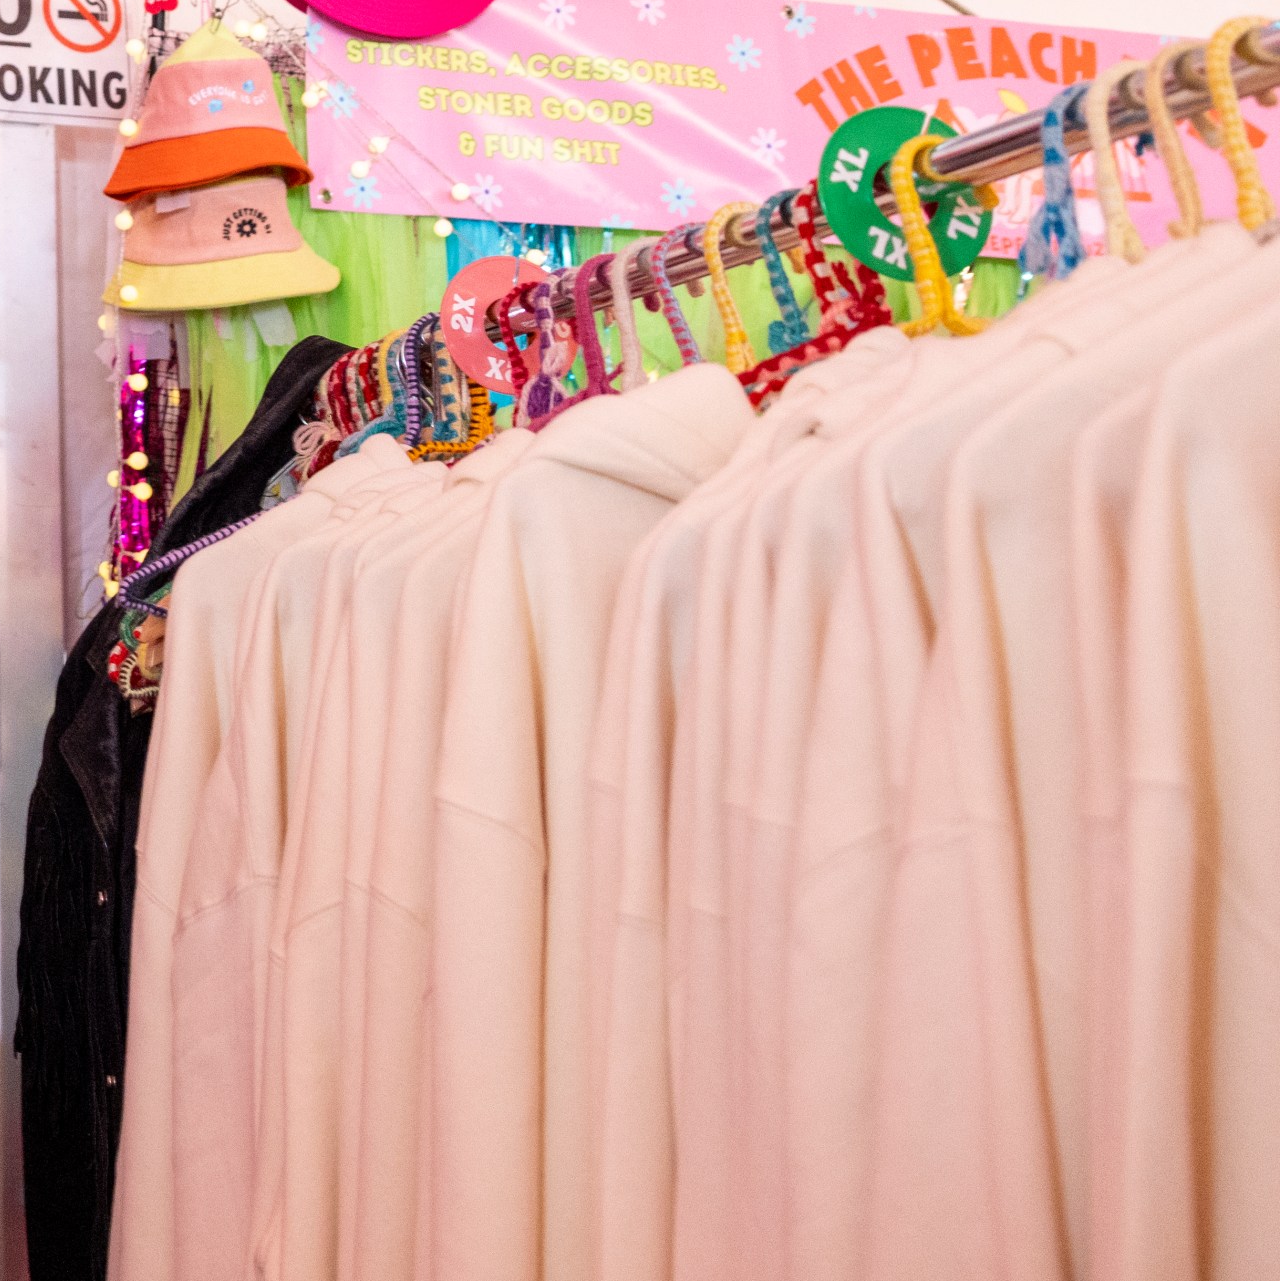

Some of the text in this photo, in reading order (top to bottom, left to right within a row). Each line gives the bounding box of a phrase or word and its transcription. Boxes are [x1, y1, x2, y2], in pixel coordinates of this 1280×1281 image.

[345, 38, 728, 94] STICKERS, ACCESSORIES,
[794, 26, 1098, 135] THE PEACH
[416, 85, 655, 128] STONER GOODS
[457, 130, 621, 166] & FUN SHIT
[829, 147, 870, 193] XL
[222, 217, 234, 241] JUST
[232, 207, 268, 223] GETTING
[946, 194, 984, 240] XL
[867, 224, 911, 271] XL
[450, 293, 477, 334] 2X
